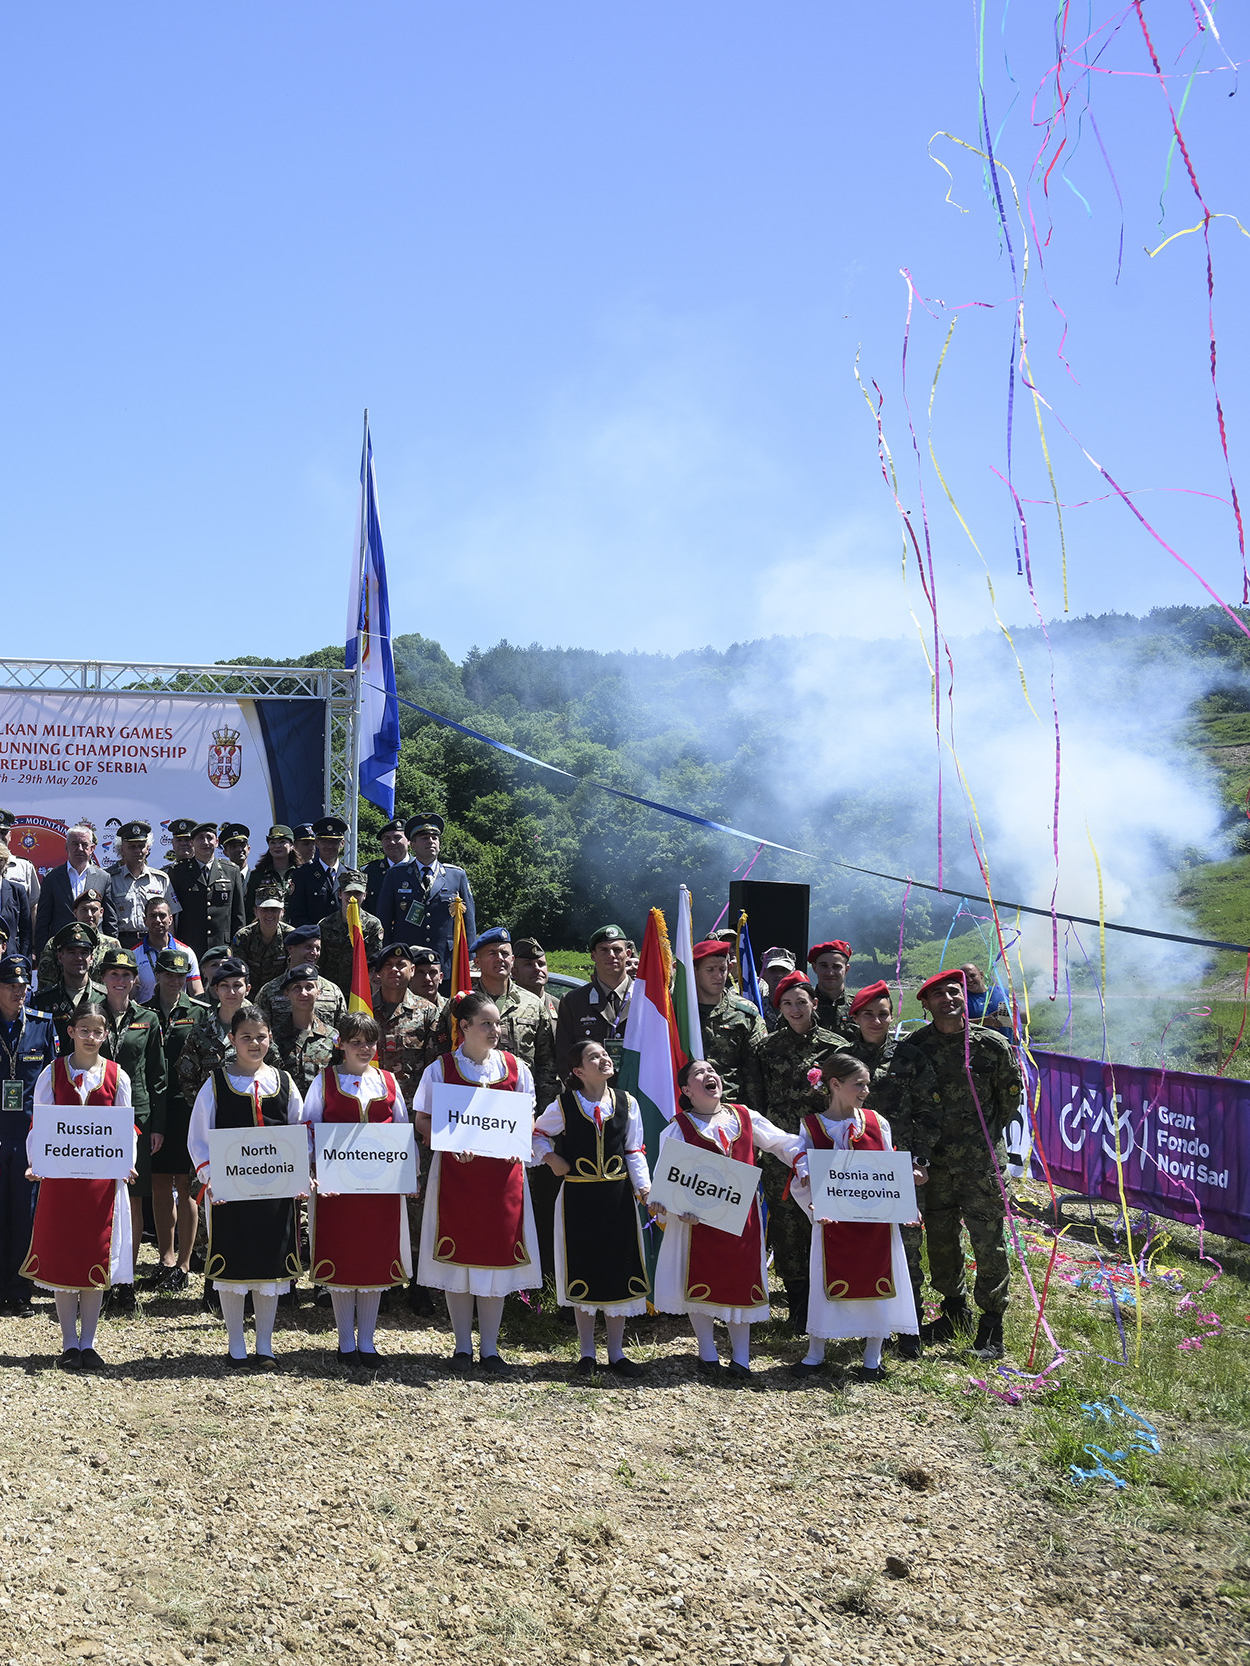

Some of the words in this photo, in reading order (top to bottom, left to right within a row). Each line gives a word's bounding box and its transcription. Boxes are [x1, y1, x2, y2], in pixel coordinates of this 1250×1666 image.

[42, 724, 116, 739] MILITARY
[119, 727, 173, 740] GAMES
[64, 743, 187, 759] CHAMPIONSHIP
[0, 758, 71, 772] REPUBLIC
[74, 760, 94, 772] OF
[97, 761, 148, 774] SERBIA
[17, 773, 43, 785] 29th
[45, 775, 70, 788] May
[70, 775, 98, 786] 2026
[25, 817, 68, 836] MOUNTAIN
[448, 1109, 517, 1134] Hungary
[1158, 1105, 1196, 1131] Gran
[56, 1121, 113, 1136] Russian
[44, 1143, 124, 1159] Federation
[241, 1144, 278, 1157] North
[1156, 1129, 1210, 1159] Fondo
[323, 1148, 409, 1164] Montenegro
[225, 1162, 295, 1177] Macedonia
[829, 1169, 869, 1181] Bosnia
[872, 1169, 895, 1182] and
[667, 1165, 742, 1206] Bulgaria
[826, 1186, 901, 1201] Herzegovina
